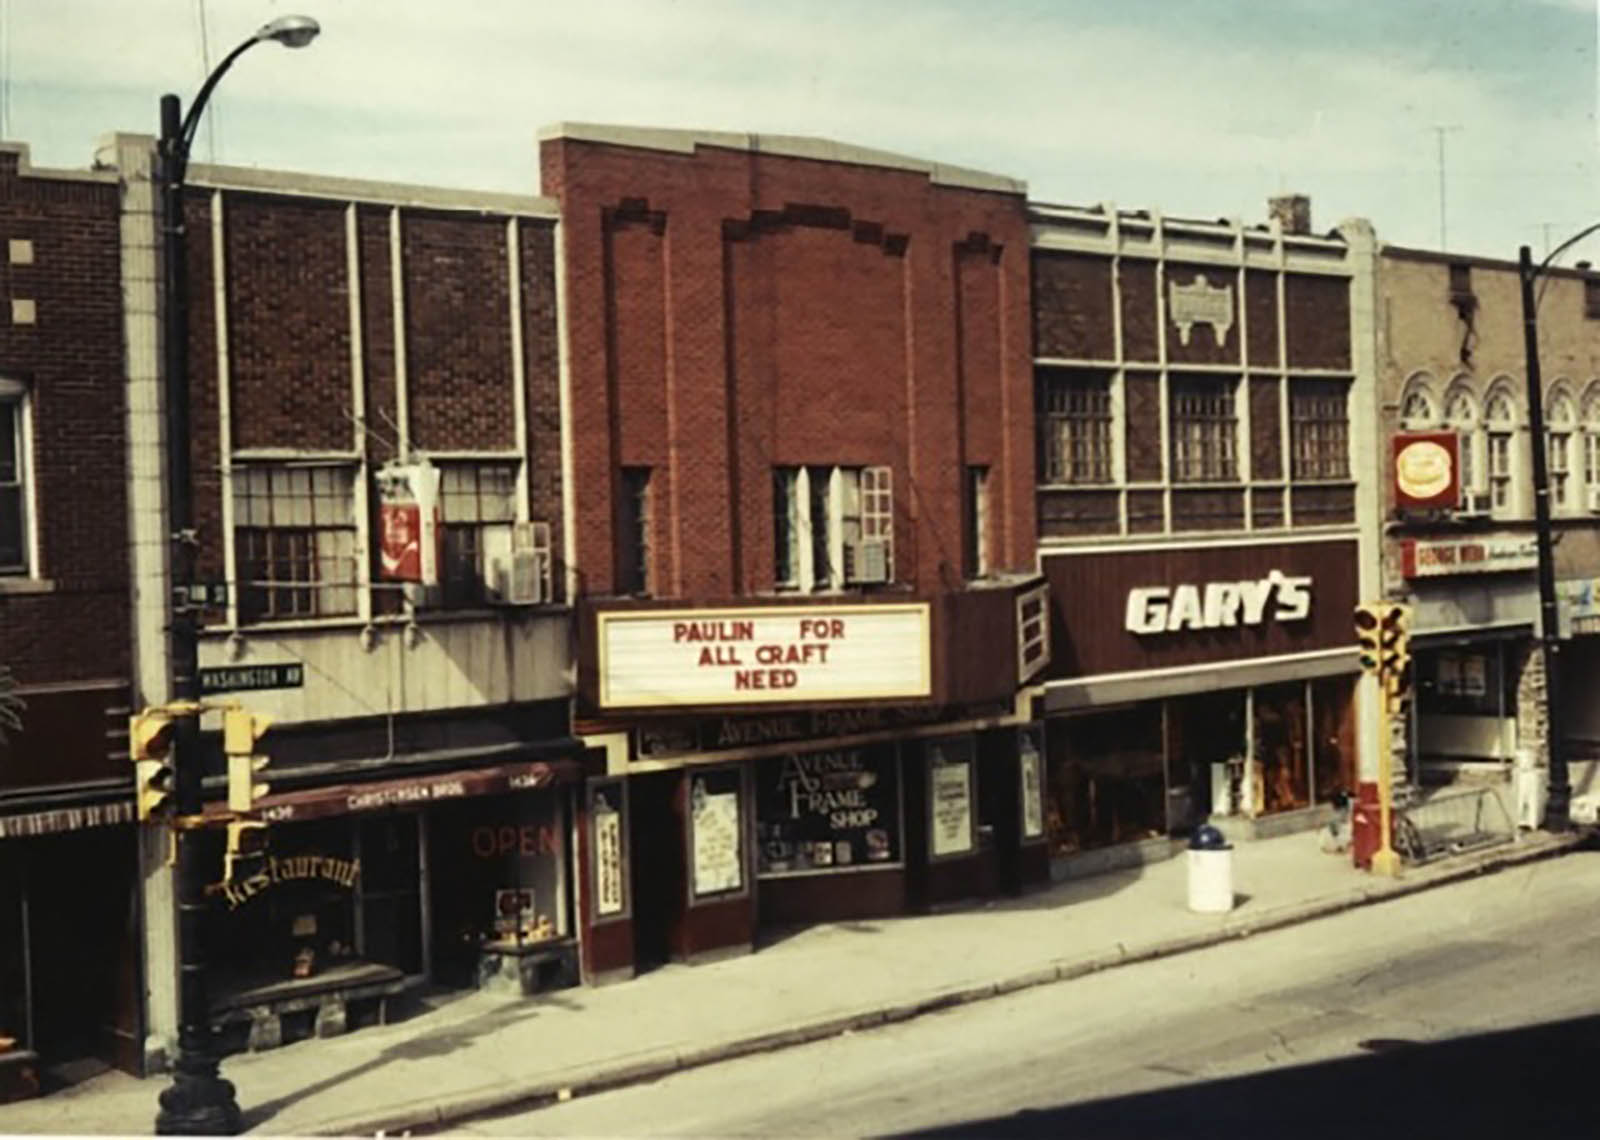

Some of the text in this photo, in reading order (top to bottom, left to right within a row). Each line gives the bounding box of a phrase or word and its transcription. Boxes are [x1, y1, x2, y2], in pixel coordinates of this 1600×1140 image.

[1125, 569, 1312, 634] GARY'S
[673, 620, 845, 642] PAULIN FOR
[698, 644, 830, 665] ALL CRAFT
[734, 670, 798, 690] NEED
[789, 780, 868, 819] FRAME
[829, 808, 879, 829] SHOP
[472, 826, 561, 858] OPEN
